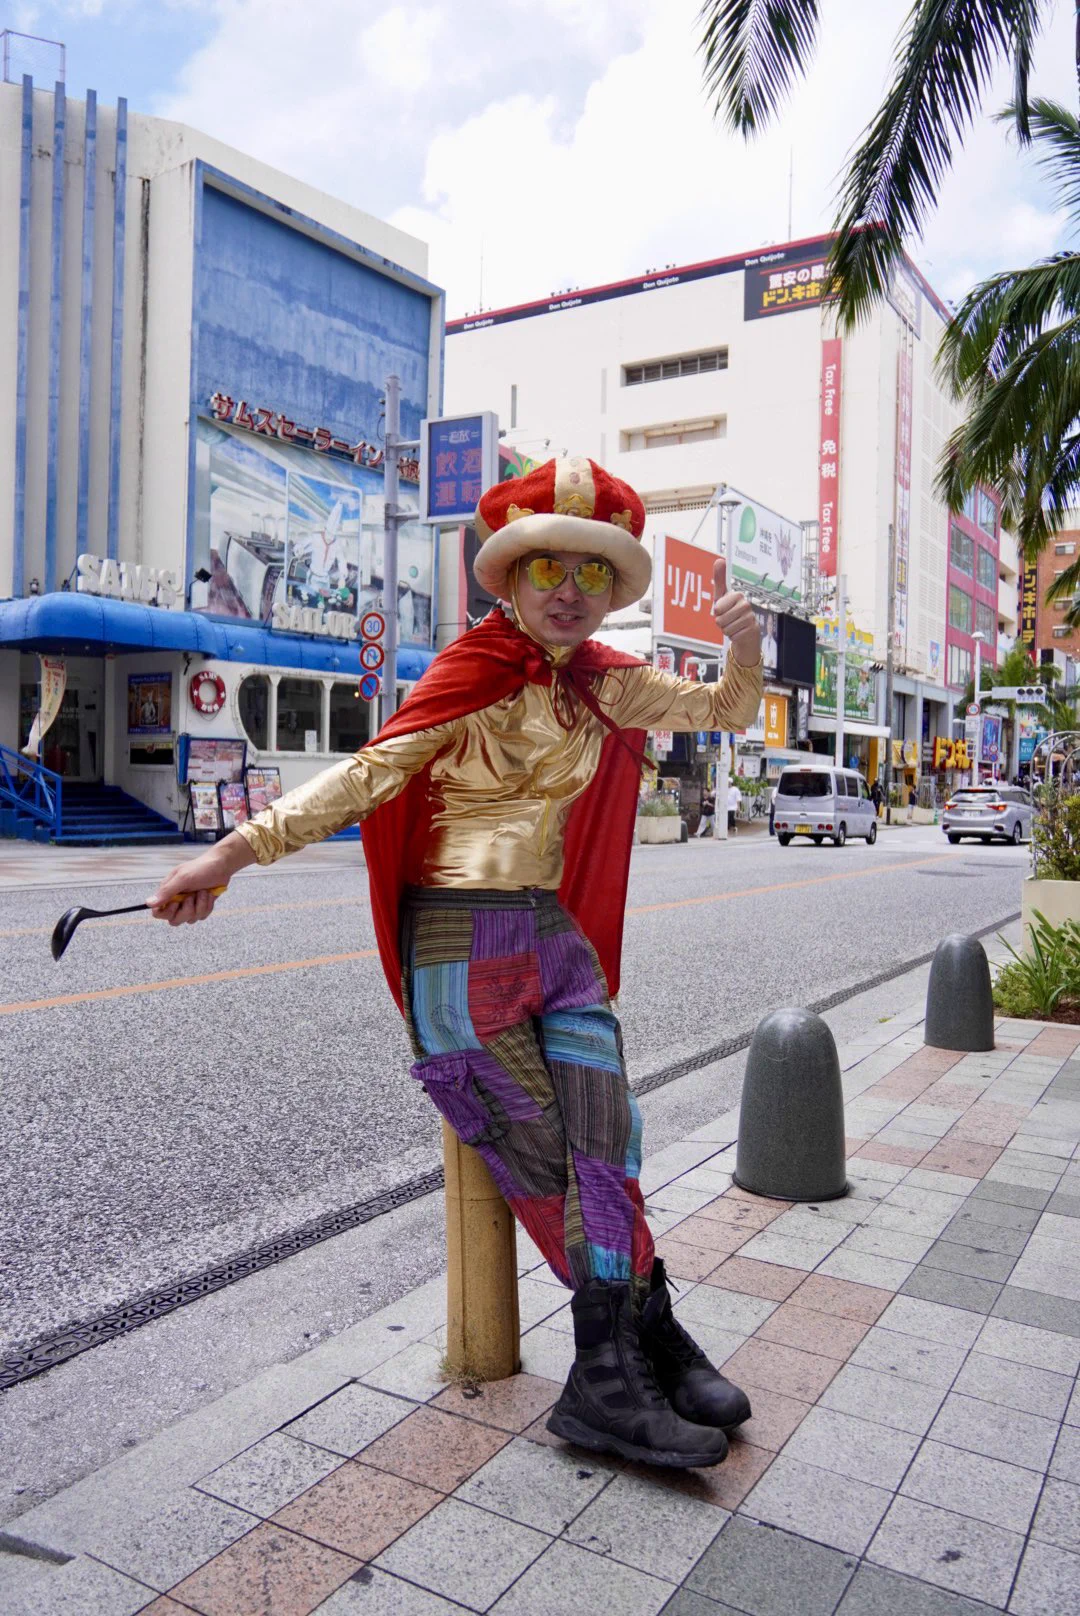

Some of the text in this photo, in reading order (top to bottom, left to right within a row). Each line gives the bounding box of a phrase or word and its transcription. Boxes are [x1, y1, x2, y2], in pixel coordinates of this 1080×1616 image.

[744, 252, 785, 267] Don Quijote
[643, 276, 680, 289] Don Quijote
[769, 261, 838, 289] 驚安の殿
[549, 298, 582, 311] Don Quijote
[824, 363, 836, 416] Tax Free
[435, 448, 483, 478] 飲酒
[821, 439, 837, 479] 免税
[435, 480, 482, 508] 運転
[821, 501, 833, 553] Tax Free
[77, 553, 177, 606] SAM'S
[271, 602, 358, 640] SAILOR
[366, 620, 380, 633] 30
